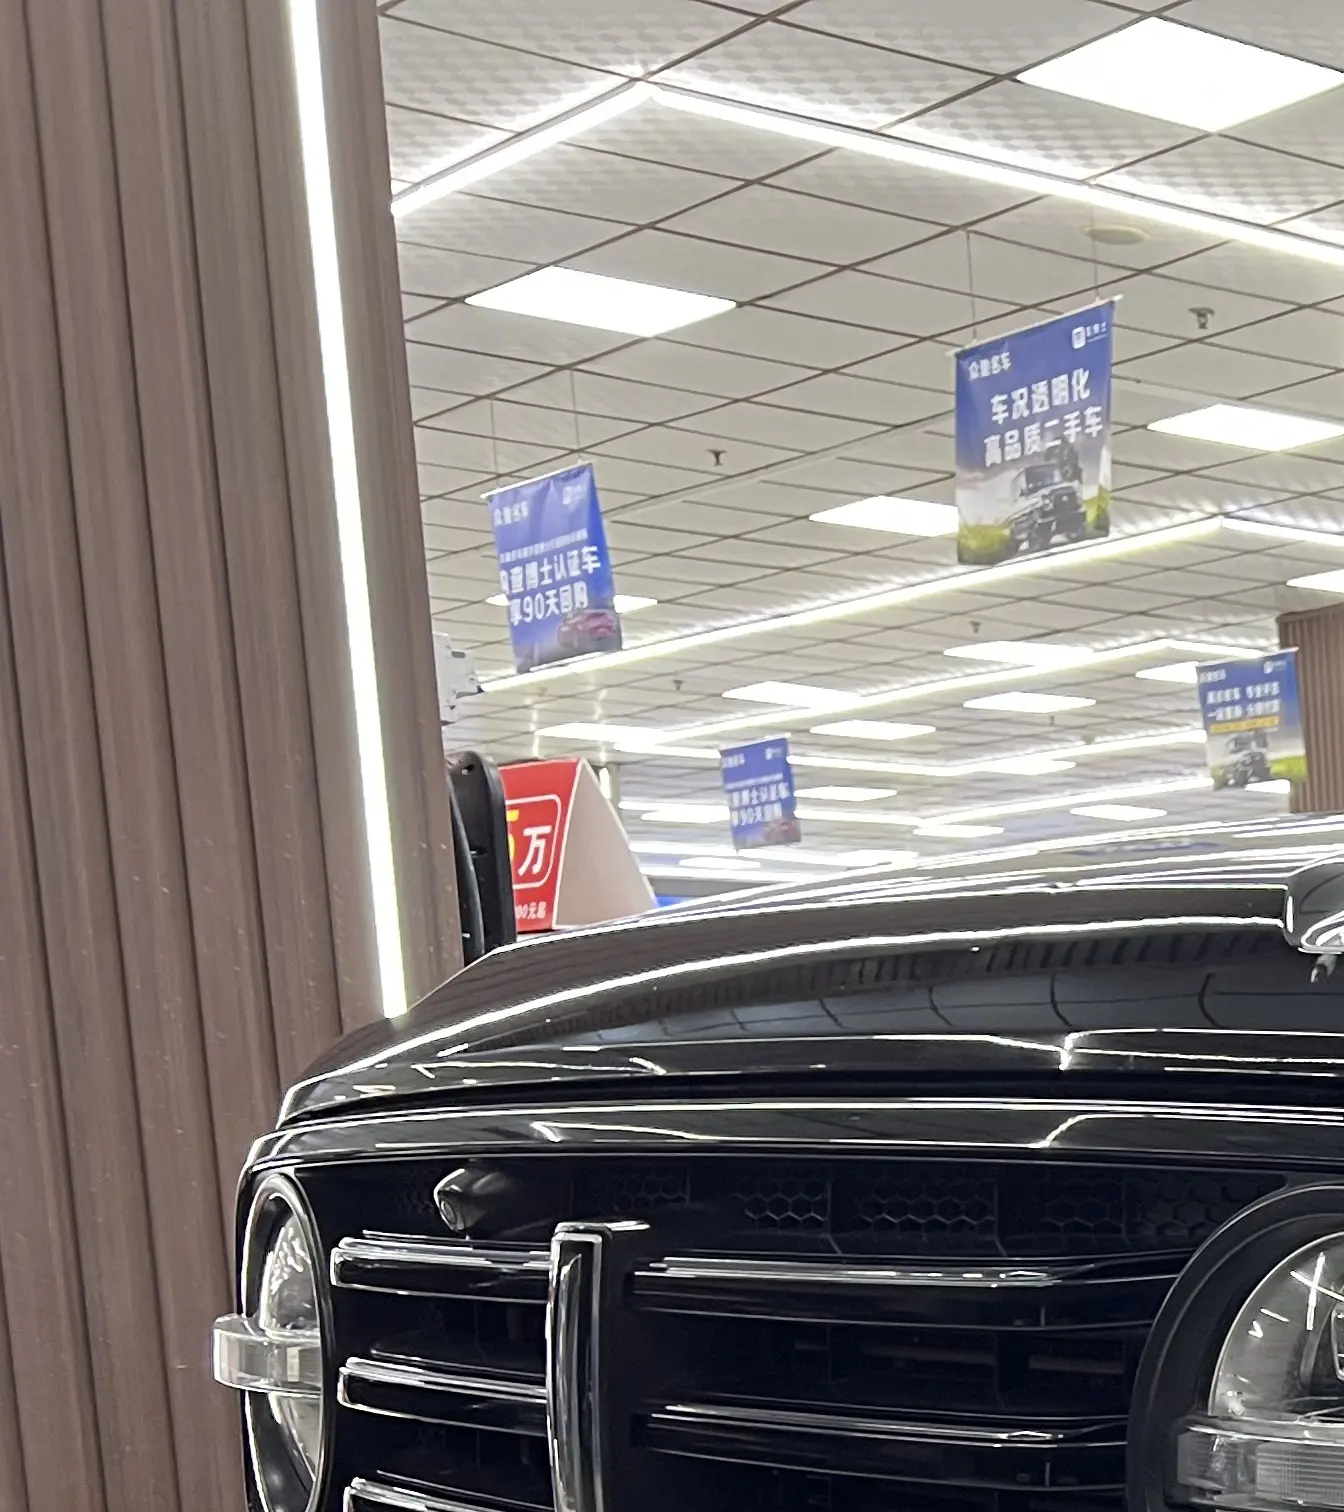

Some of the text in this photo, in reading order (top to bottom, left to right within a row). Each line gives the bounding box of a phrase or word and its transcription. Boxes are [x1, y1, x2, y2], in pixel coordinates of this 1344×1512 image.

[990, 367, 1091, 425] 车况透明化
[983, 405, 1104, 468] 高品质二手车
